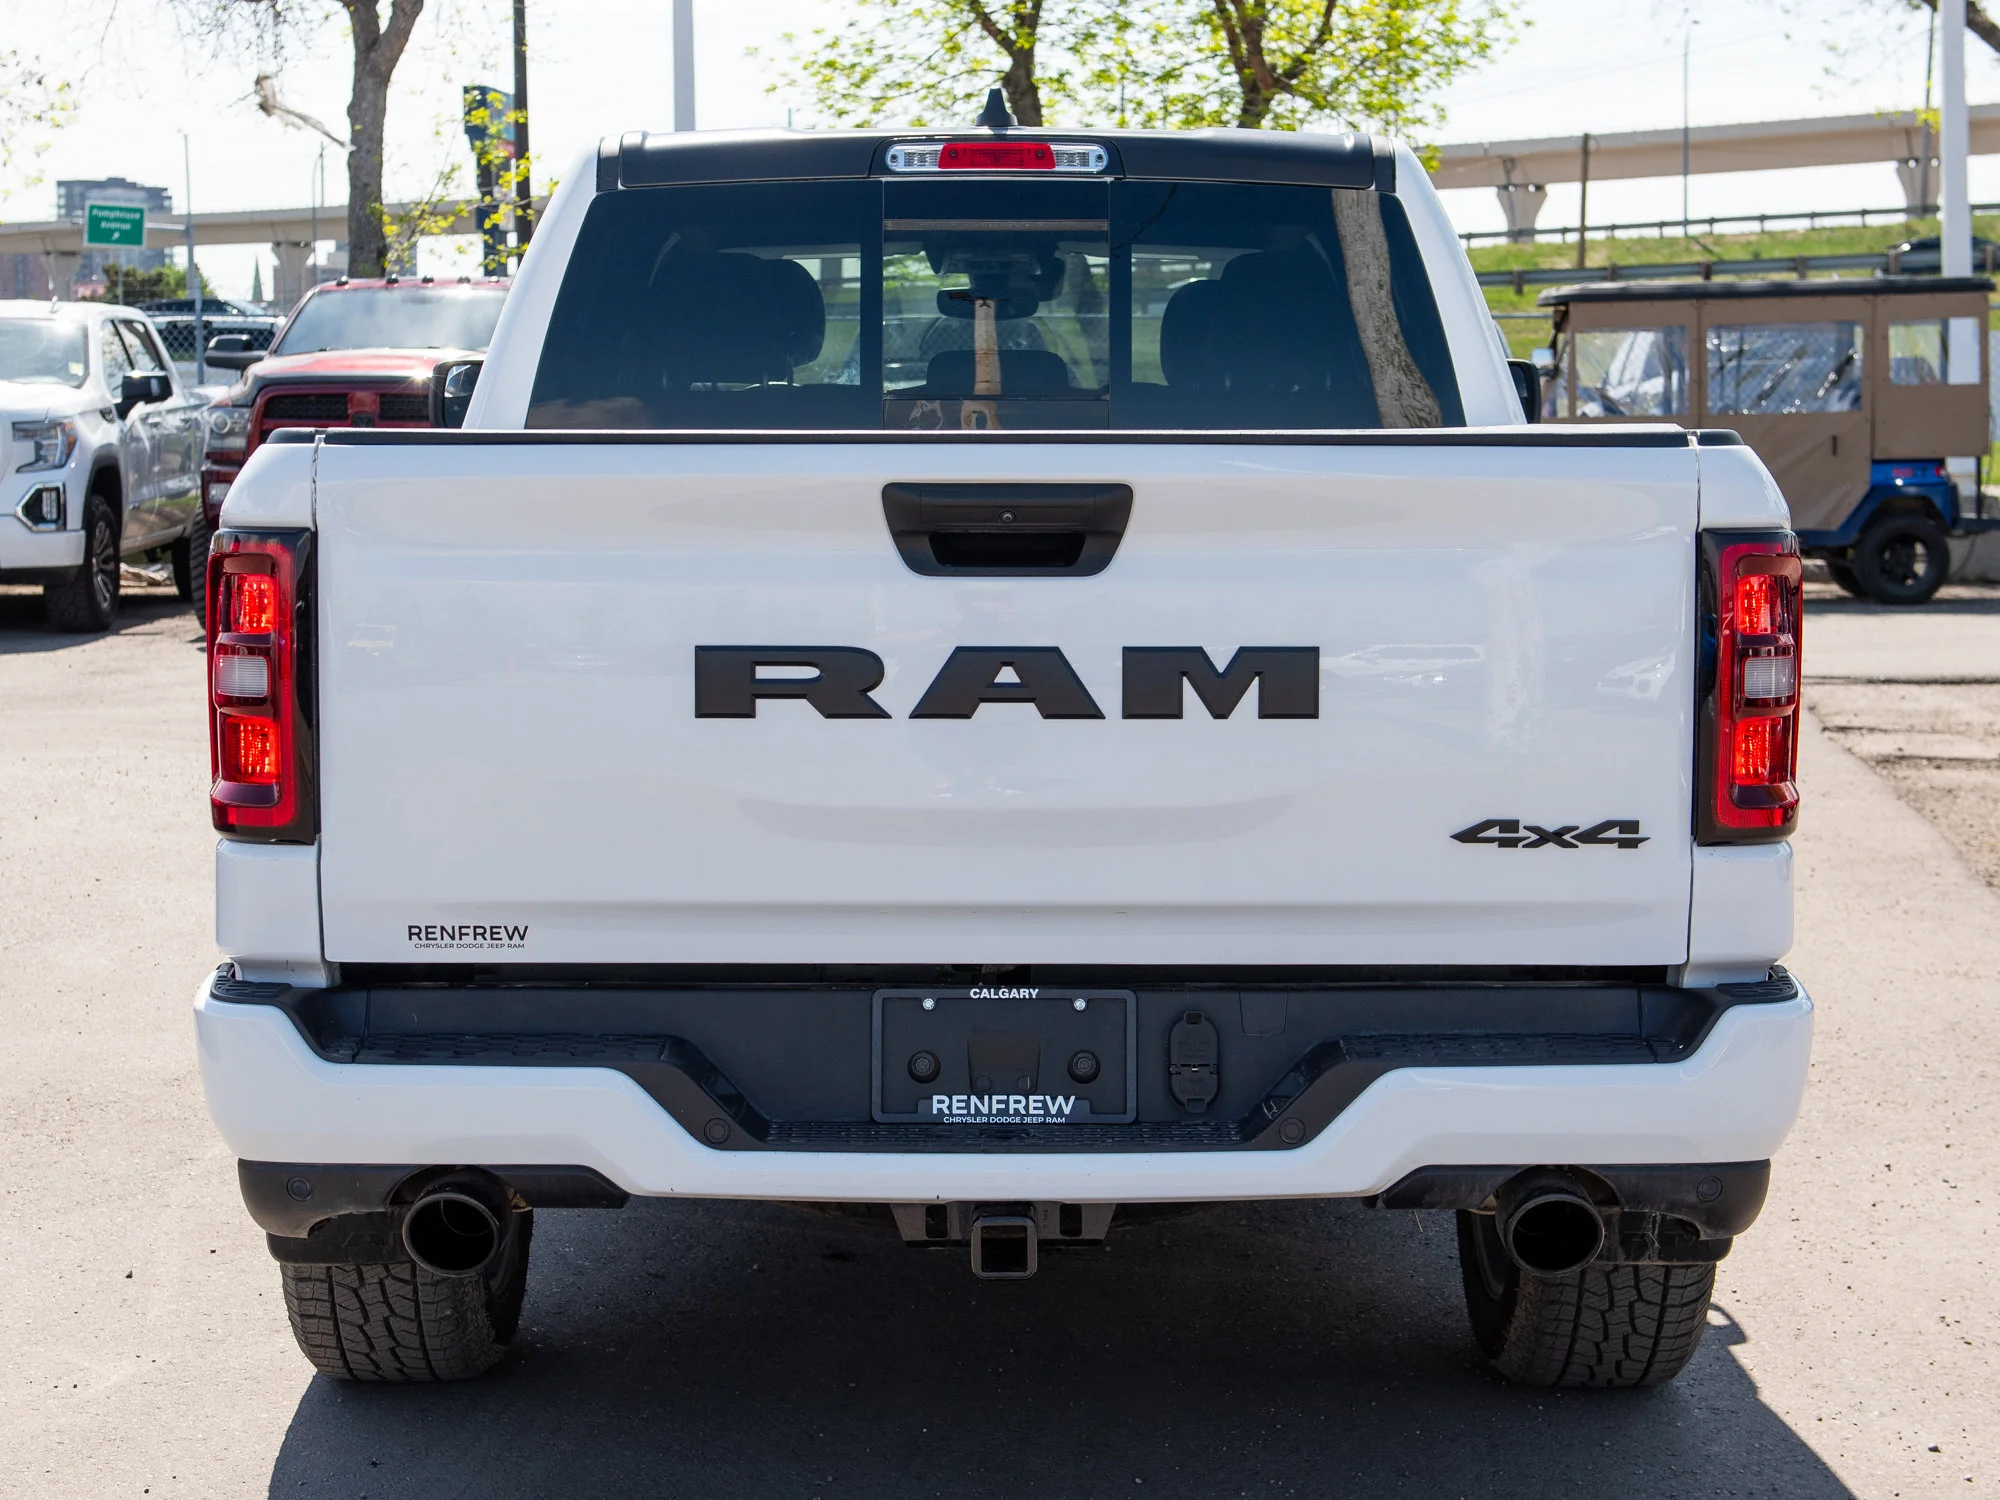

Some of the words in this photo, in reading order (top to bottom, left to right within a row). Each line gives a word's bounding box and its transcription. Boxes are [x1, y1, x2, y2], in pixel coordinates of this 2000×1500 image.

[92, 208, 140, 220] Pumphouse
[100, 221, 131, 230] Avenue
[694, 645, 1320, 720] RAM
[1449, 818, 1652, 849] 4x4
[407, 925, 529, 941] RENFREW
[969, 988, 1039, 999] CALGARY
[932, 1095, 1076, 1115] RENFREW
[943, 1116, 988, 1124] CHRYSLER
[989, 1116, 1021, 1124] DODGE
[1022, 1116, 1044, 1124] JEEP
[1045, 1116, 1066, 1124] RAM
